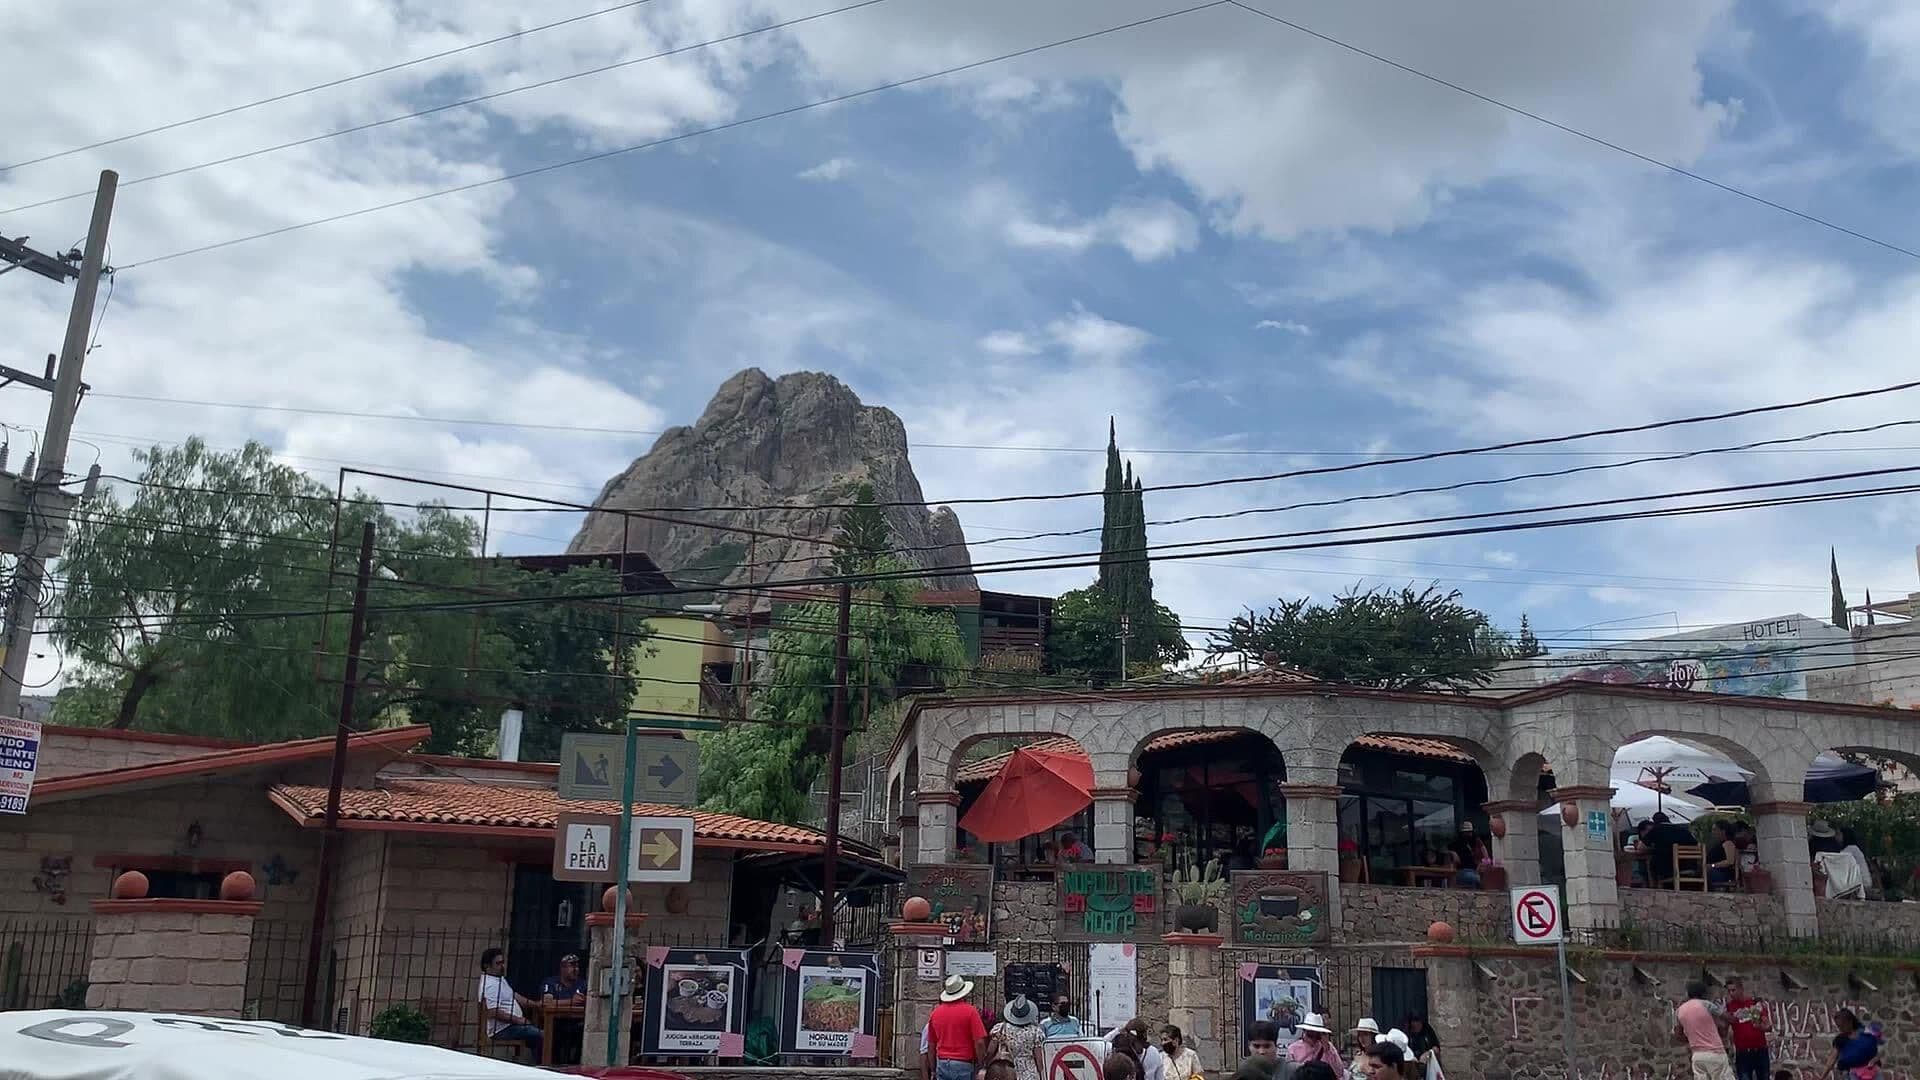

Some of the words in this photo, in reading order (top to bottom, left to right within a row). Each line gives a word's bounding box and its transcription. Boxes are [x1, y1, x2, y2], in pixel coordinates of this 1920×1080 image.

[1743, 619, 1797, 641] HOTEL
[584, 828, 593, 839] A
[580, 841, 597, 853] LA
[808, 1033, 848, 1042] NOPALITOS
